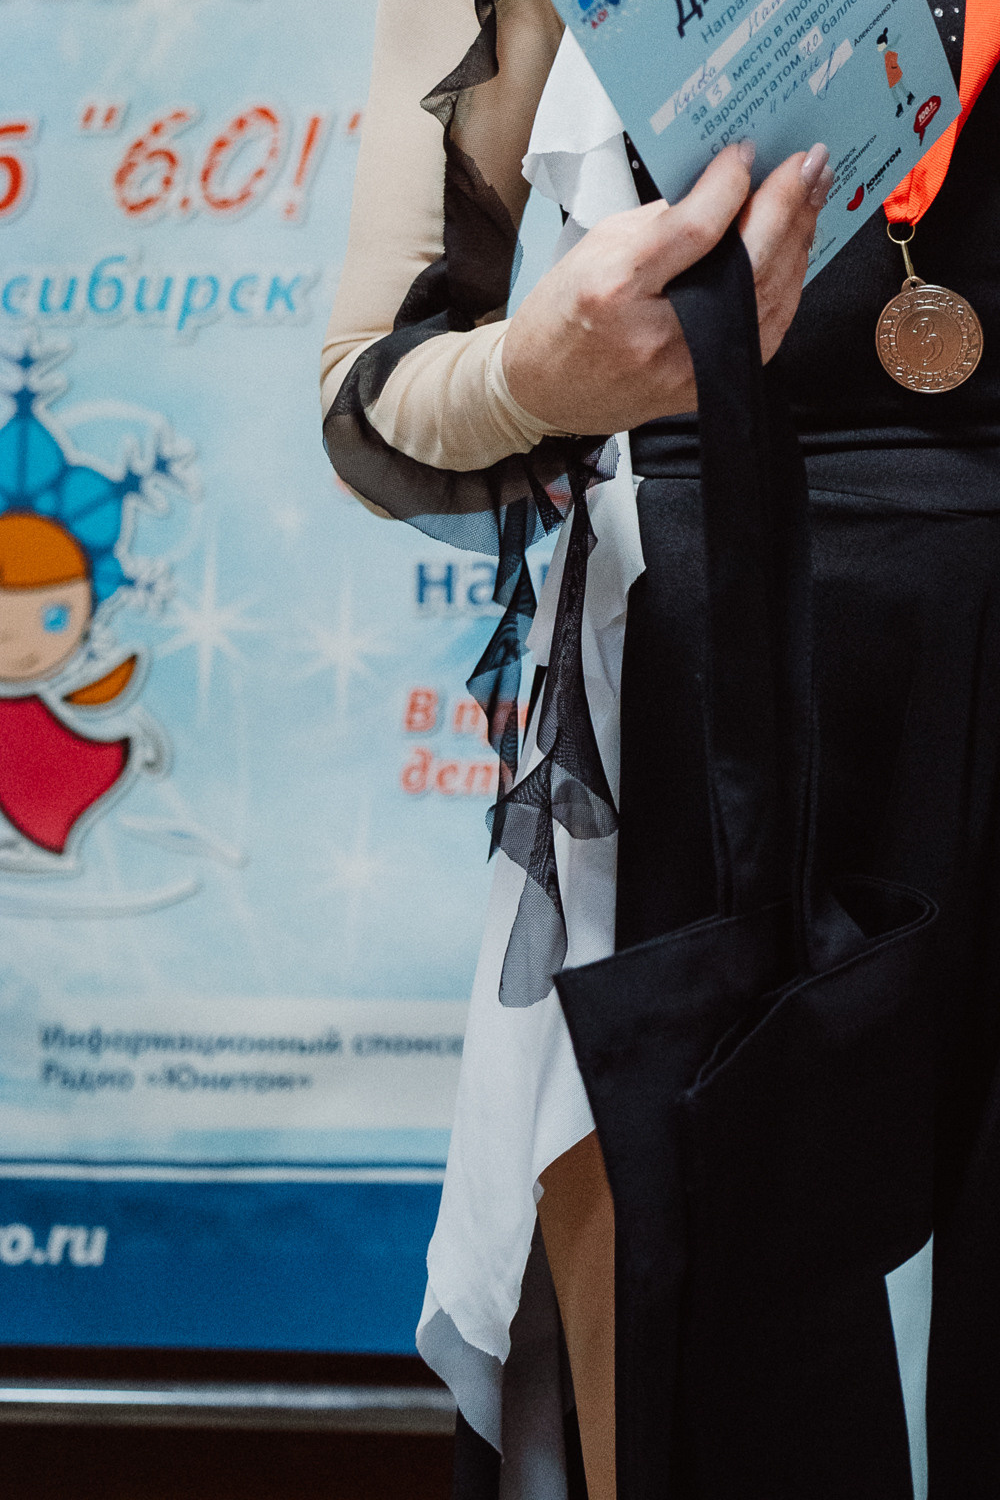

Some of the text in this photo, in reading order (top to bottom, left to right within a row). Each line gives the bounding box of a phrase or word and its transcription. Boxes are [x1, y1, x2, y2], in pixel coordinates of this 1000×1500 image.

[853, 2, 891, 47] Алексеенко
[691, 104, 708, 125] за
[731, 35, 772, 81] место
[772, 24, 783, 38] в
[699, 61, 772, 141] «Взрослая»
[719, 53, 801, 147] результатом
[865, 146, 902, 190] ЮНИТОН
